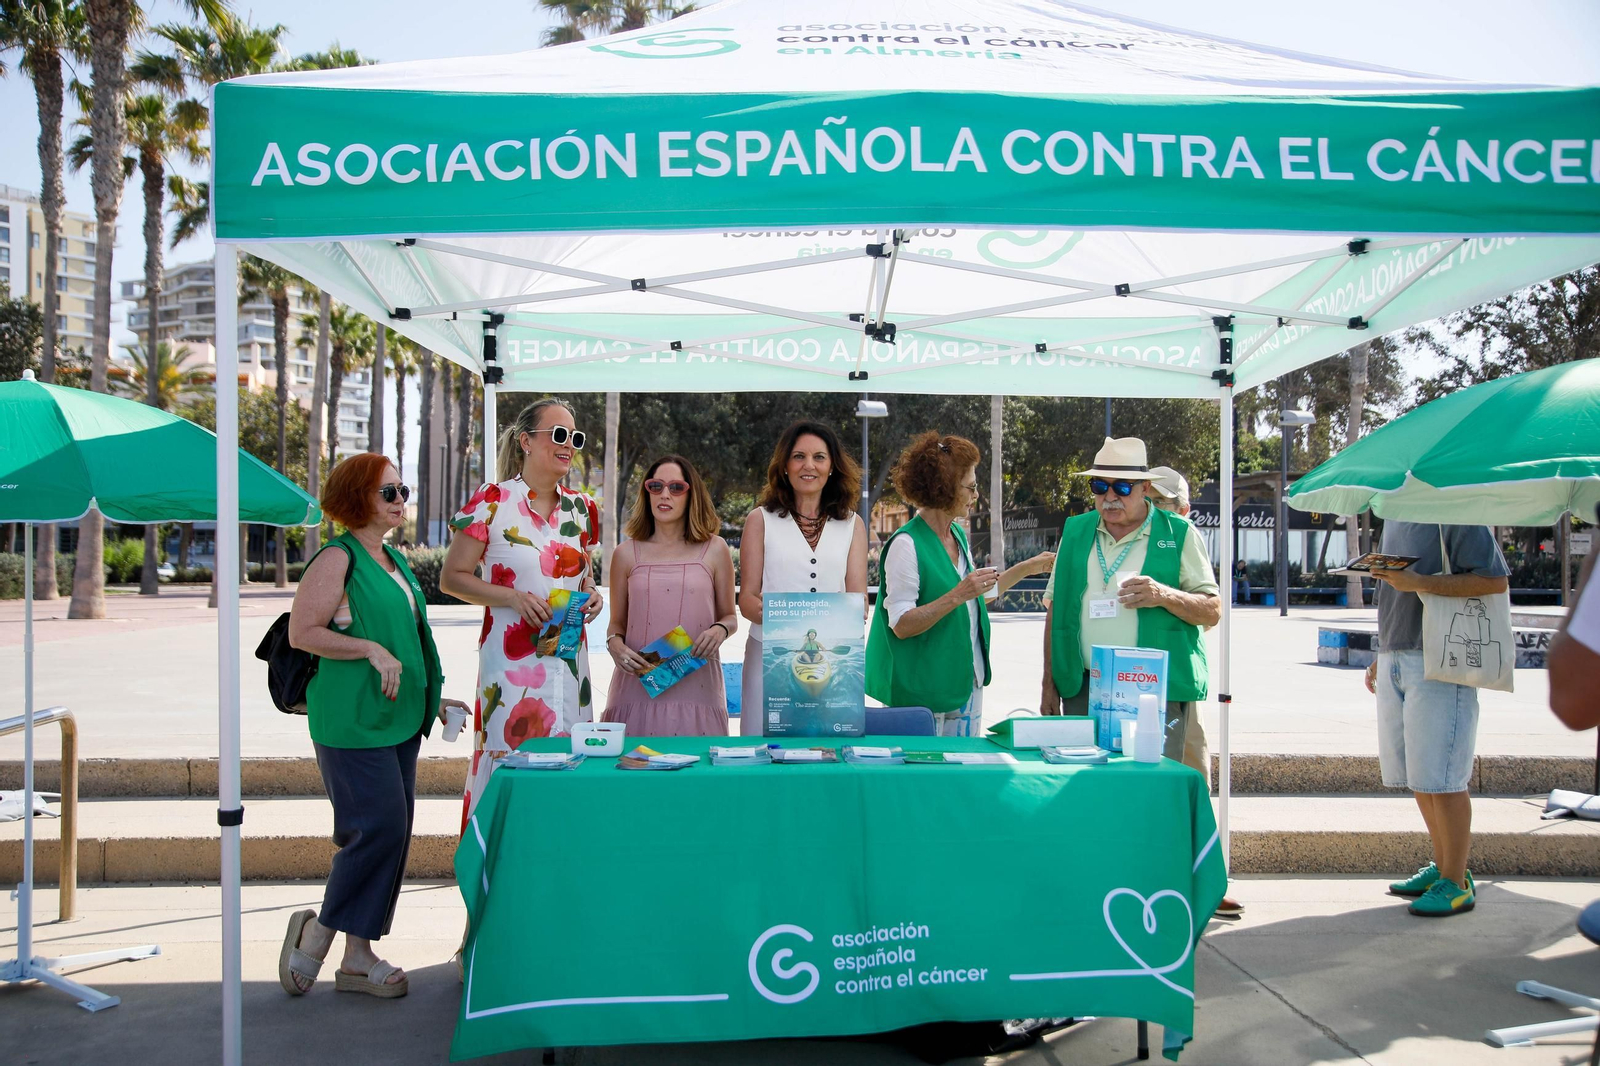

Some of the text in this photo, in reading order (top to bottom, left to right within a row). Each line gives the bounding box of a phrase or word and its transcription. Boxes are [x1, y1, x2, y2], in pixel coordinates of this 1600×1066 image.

[777, 21, 1007, 34] asociación
[776, 34, 920, 44] contra
[933, 35, 971, 46] el
[776, 45, 1022, 60] en Almería
[251, 129, 637, 187] ASOCIACIÓN
[658, 115, 988, 178] ESPAÑOLA
[1001, 128, 1265, 180] CONTRA
[1278, 136, 1355, 181] EL
[768, 599, 787, 608] Está
[768, 610, 788, 619] pero
[801, 608, 818, 619] piel
[1117, 671, 1159, 684] BEZOYA
[831, 921, 930, 948] asociación
[833, 945, 916, 974] española
[835, 965, 989, 995] contra el cáncer
